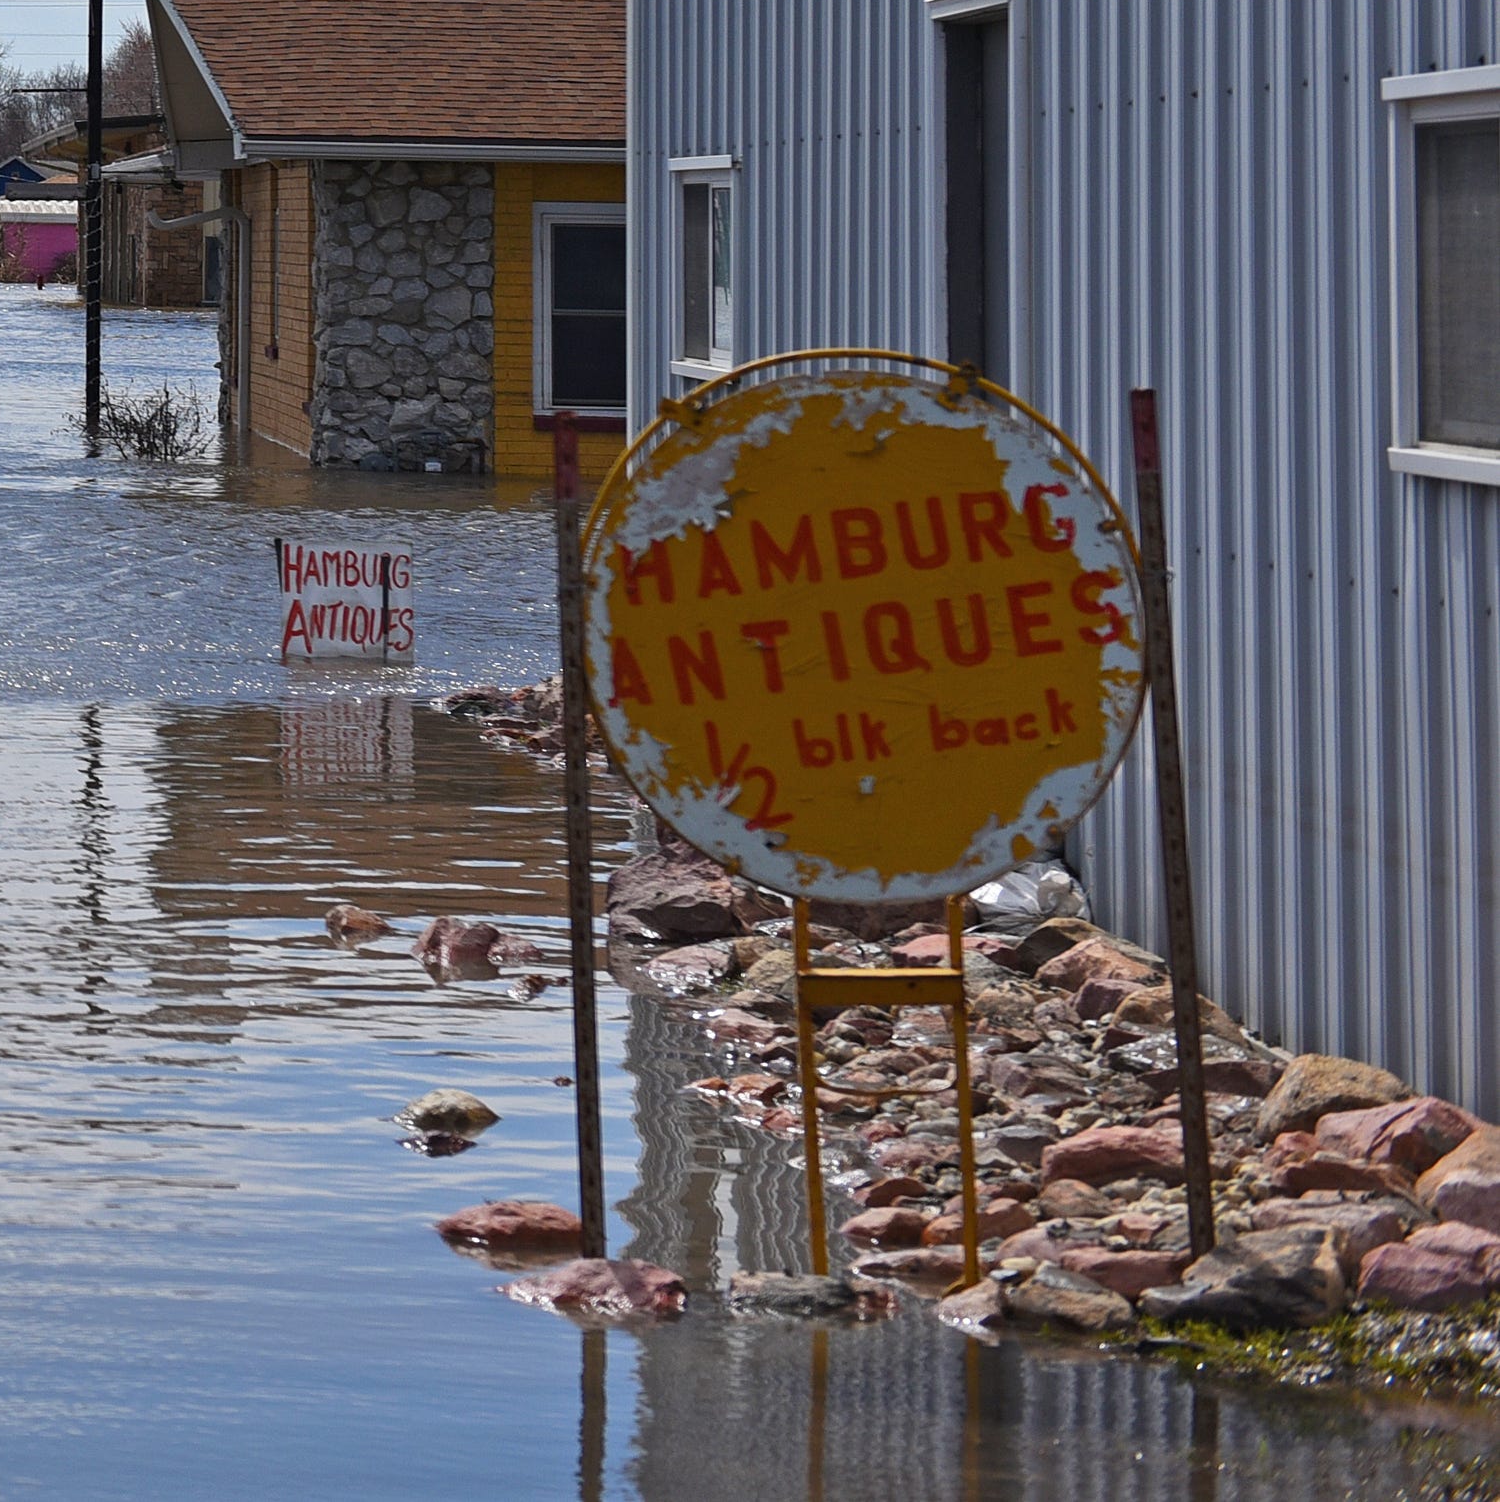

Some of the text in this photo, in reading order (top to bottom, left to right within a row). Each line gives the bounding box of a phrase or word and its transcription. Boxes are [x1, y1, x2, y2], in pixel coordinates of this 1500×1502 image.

[621, 482, 1077, 607] HAMBURG
[281, 599, 414, 655] ANTIQUES
[609, 570, 1122, 707] ANTIQUES
[793, 712, 892, 769] blk
[928, 688, 1078, 752] back
